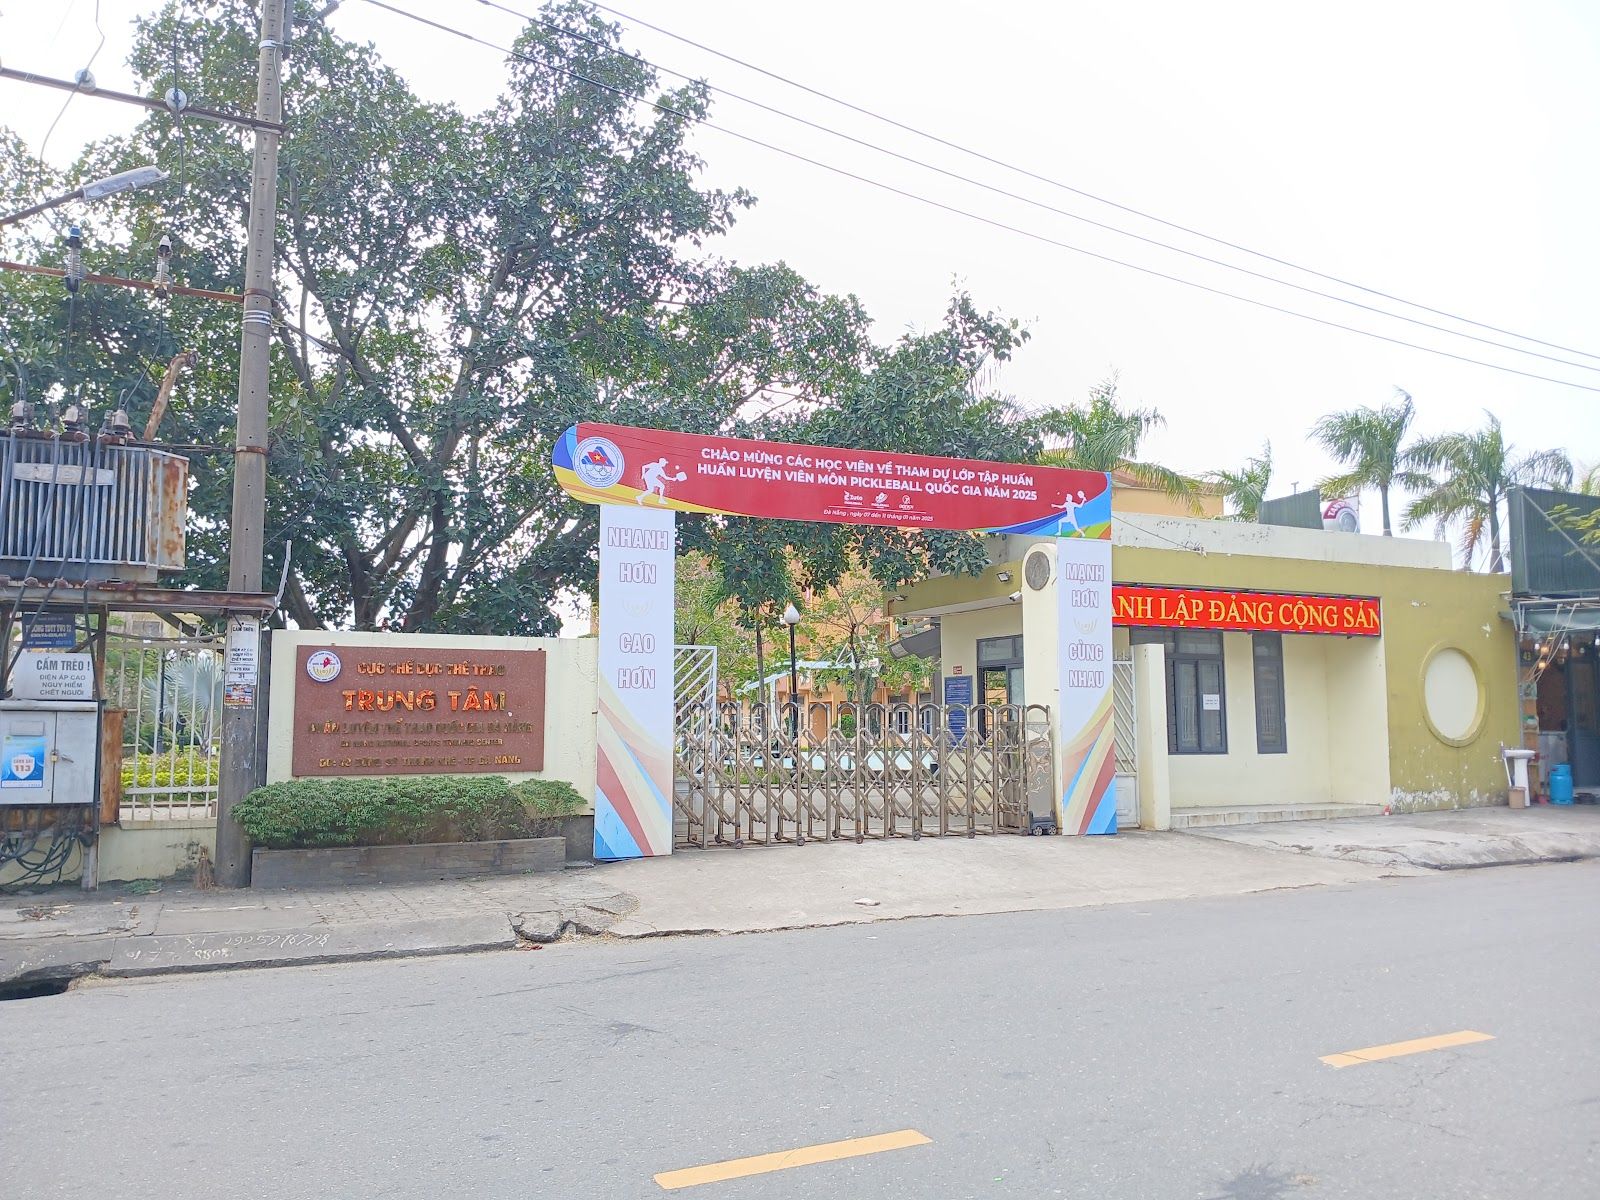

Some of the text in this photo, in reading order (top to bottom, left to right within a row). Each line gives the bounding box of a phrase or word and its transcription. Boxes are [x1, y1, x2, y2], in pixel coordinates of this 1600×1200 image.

[701, 448, 1034, 486] CHÀO MỪNG CÁC HỌC VIÊN VỀ THAM DỰ LỚP TẬP HUẤN
[697, 462, 1038, 501] HUẤN LUYỆN VIÊN MÔN PICKLEBALL QUỐC GIA NĂM 2025
[608, 526, 668, 550] NHANH
[619, 561, 656, 584] HƠN
[1066, 563, 1104, 584] MẠNH
[1072, 588, 1099, 608] HƠN
[1159, 594, 1204, 626] LẬP
[1208, 595, 1274, 625] ĐẢNG
[1278, 600, 1338, 630] CỘNG
[619, 632, 656, 654] CAO
[1068, 639, 1103, 661] CÙNG
[36, 656, 58, 670] CẤM
[357, 662, 386, 677] CỤC
[416, 663, 443, 677] DỤC
[447, 660, 471, 676] THỂ
[472, 664, 506, 676] THAO
[618, 666, 656, 689] HƠN
[1068, 670, 1104, 688] NHAU
[342, 685, 506, 712] TRUNG TÂM
